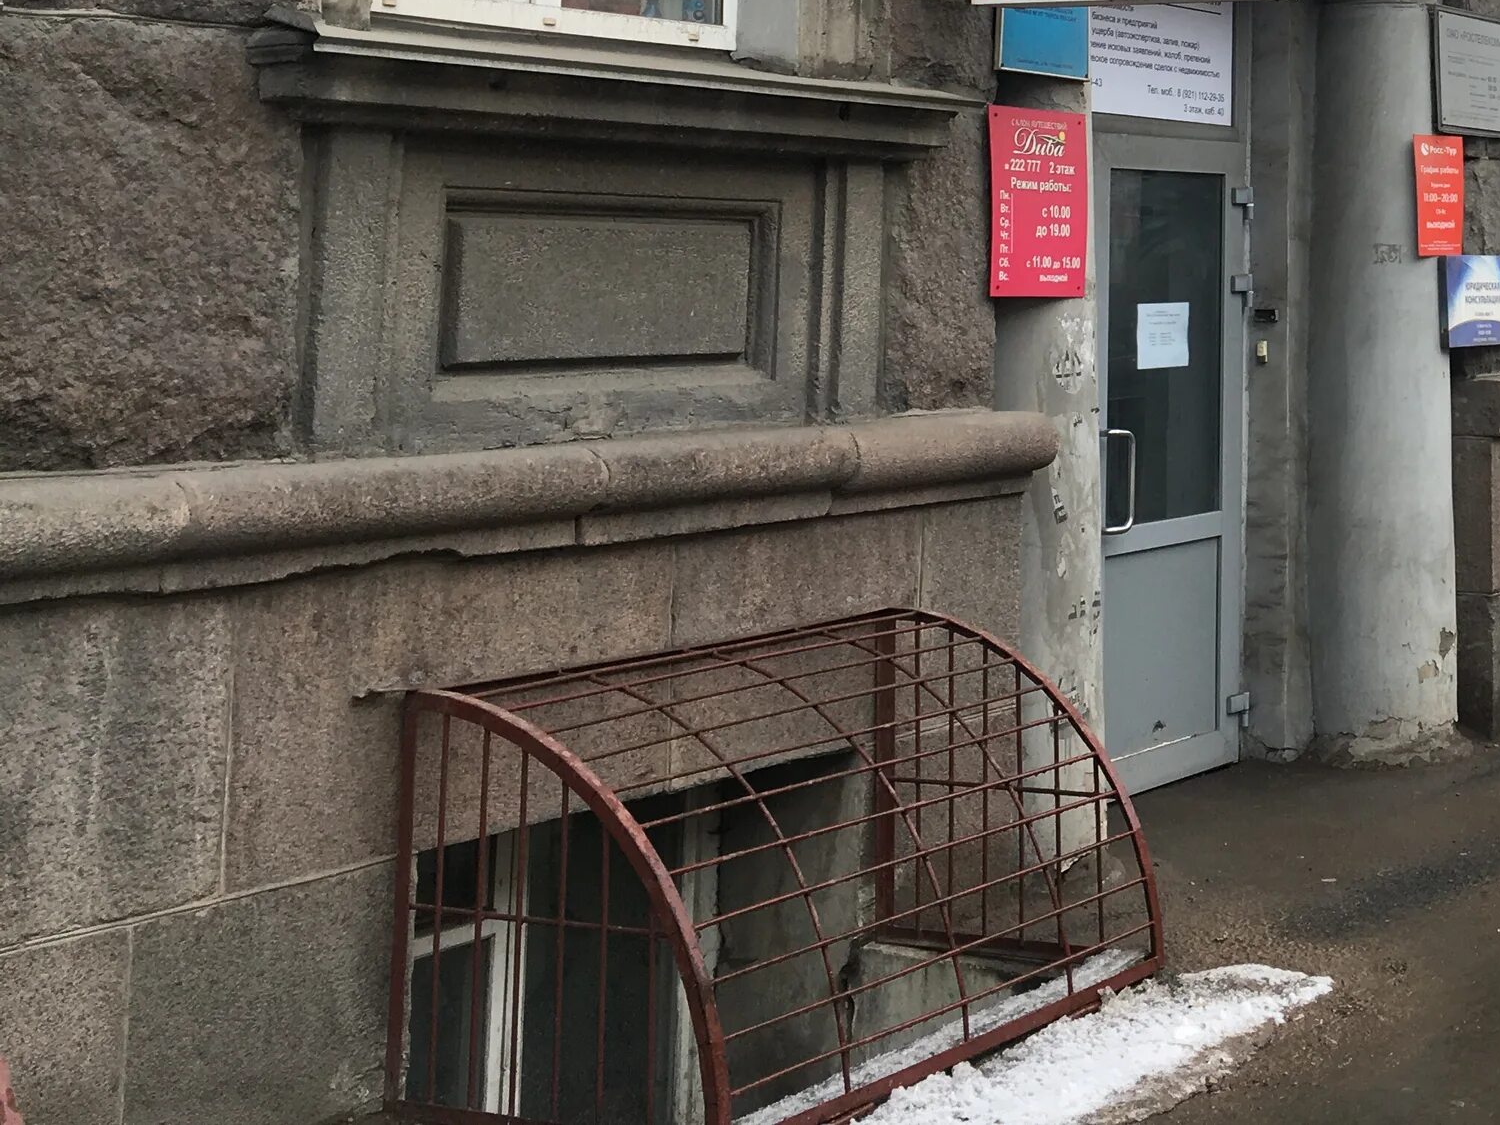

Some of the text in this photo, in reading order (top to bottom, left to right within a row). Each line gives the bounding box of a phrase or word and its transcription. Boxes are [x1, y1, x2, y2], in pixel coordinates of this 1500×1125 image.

[1010, 158, 1025, 171] 222
[1026, 159, 1041, 172] 777
[1056, 165, 1075, 175] этаж
[1011, 176, 1038, 190] Режим
[1050, 205, 1071, 219] 10.00
[1036, 223, 1071, 238] до 19.00
[1032, 255, 1052, 268] 11.00
[1062, 256, 1081, 269] 15.00
